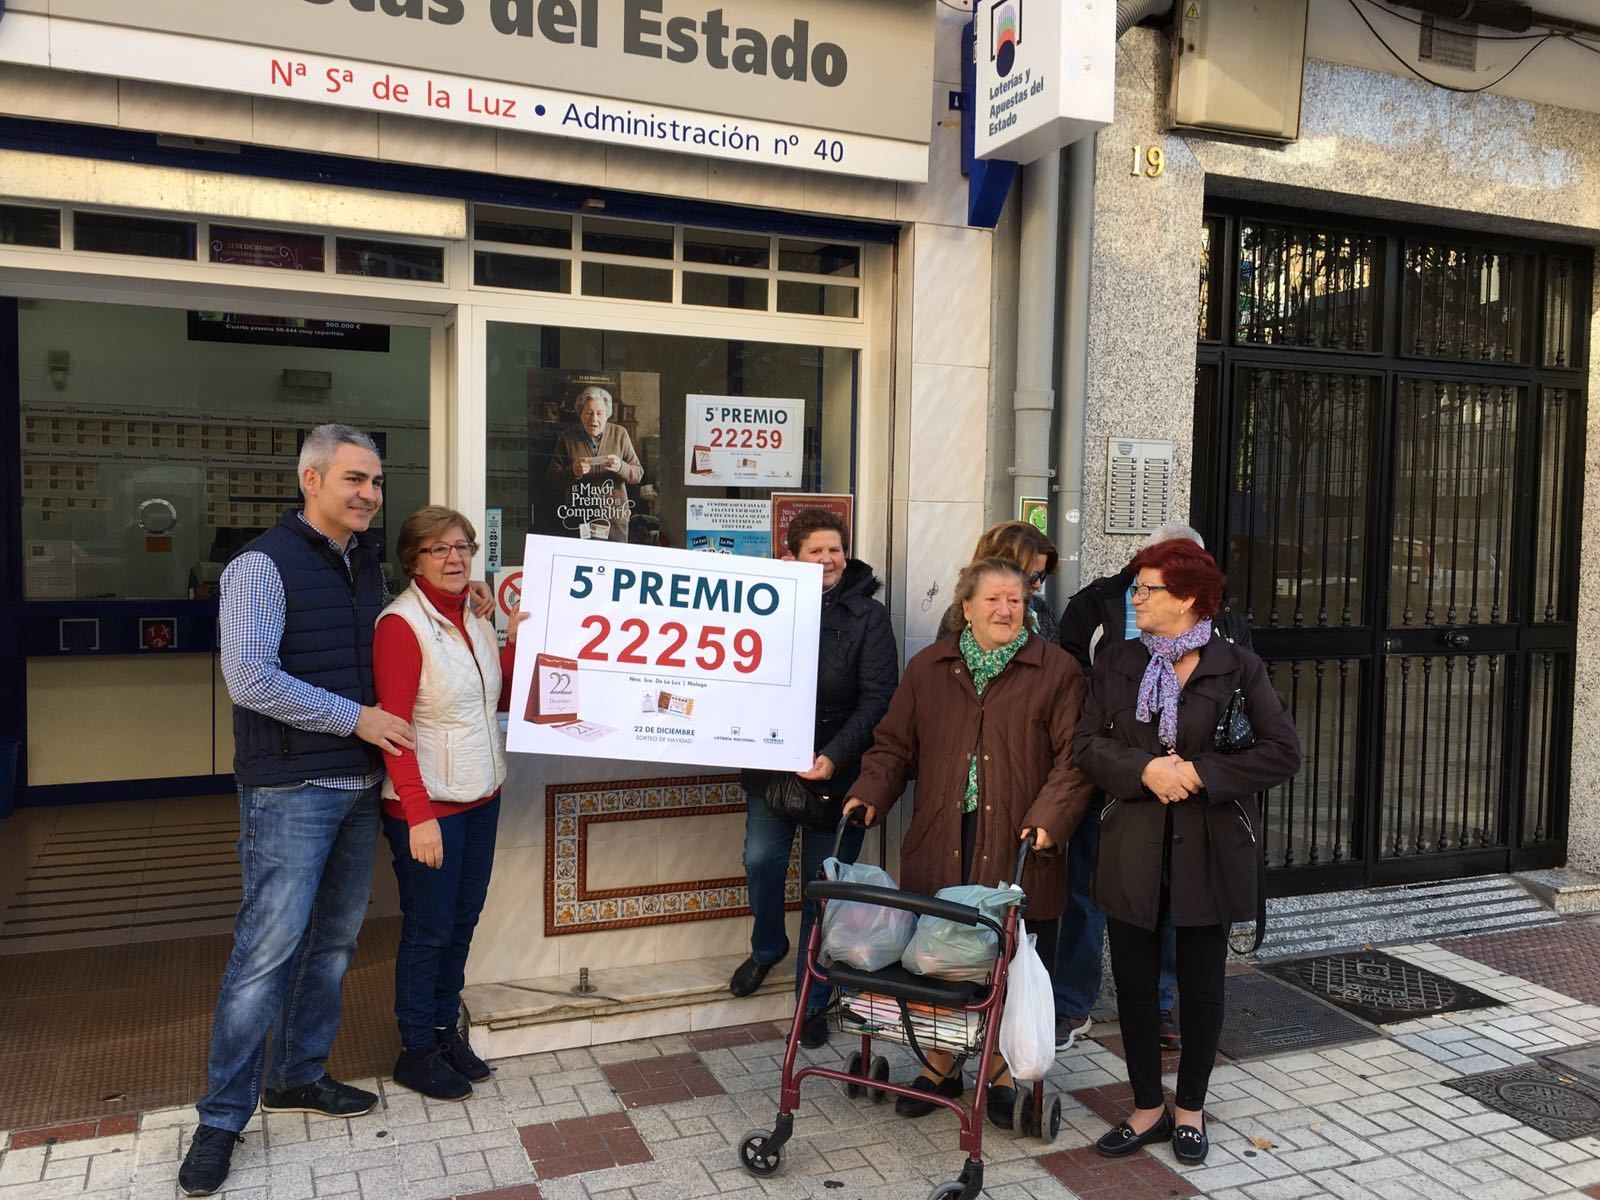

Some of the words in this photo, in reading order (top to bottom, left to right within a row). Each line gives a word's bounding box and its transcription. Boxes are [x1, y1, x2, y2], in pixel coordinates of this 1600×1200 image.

[623, 0, 848, 87] Estado
[371, 74, 409, 103] de
[427, 80, 451, 109] la
[467, 87, 517, 118] Luz
[989, 72, 1023, 100] Loterías
[1025, 67, 1031, 82] y
[989, 91, 1028, 119] Apuestas
[1030, 77, 1044, 97] del
[561, 102, 760, 152] Administración
[813, 138, 844, 162] 40
[988, 111, 1018, 137] Estado
[1130, 145, 1166, 177] 19
[225, 323, 250, 331] Cuarto
[250, 326, 275, 334] premio
[314, 329, 344, 337] repartido
[721, 407, 788, 425] PREMIO
[710, 427, 782, 449] 22259
[572, 492, 615, 506] Premio
[580, 479, 615, 498] Mayor
[612, 567, 780, 616] PREMIO
[577, 614, 763, 673] 22259
[549, 672, 572, 694] 22
[634, 725, 644, 733] 22
[645, 726, 655, 734] DE
[656, 727, 696, 737] DICIEMBRE
[635, 734, 658, 743] SORTEO
